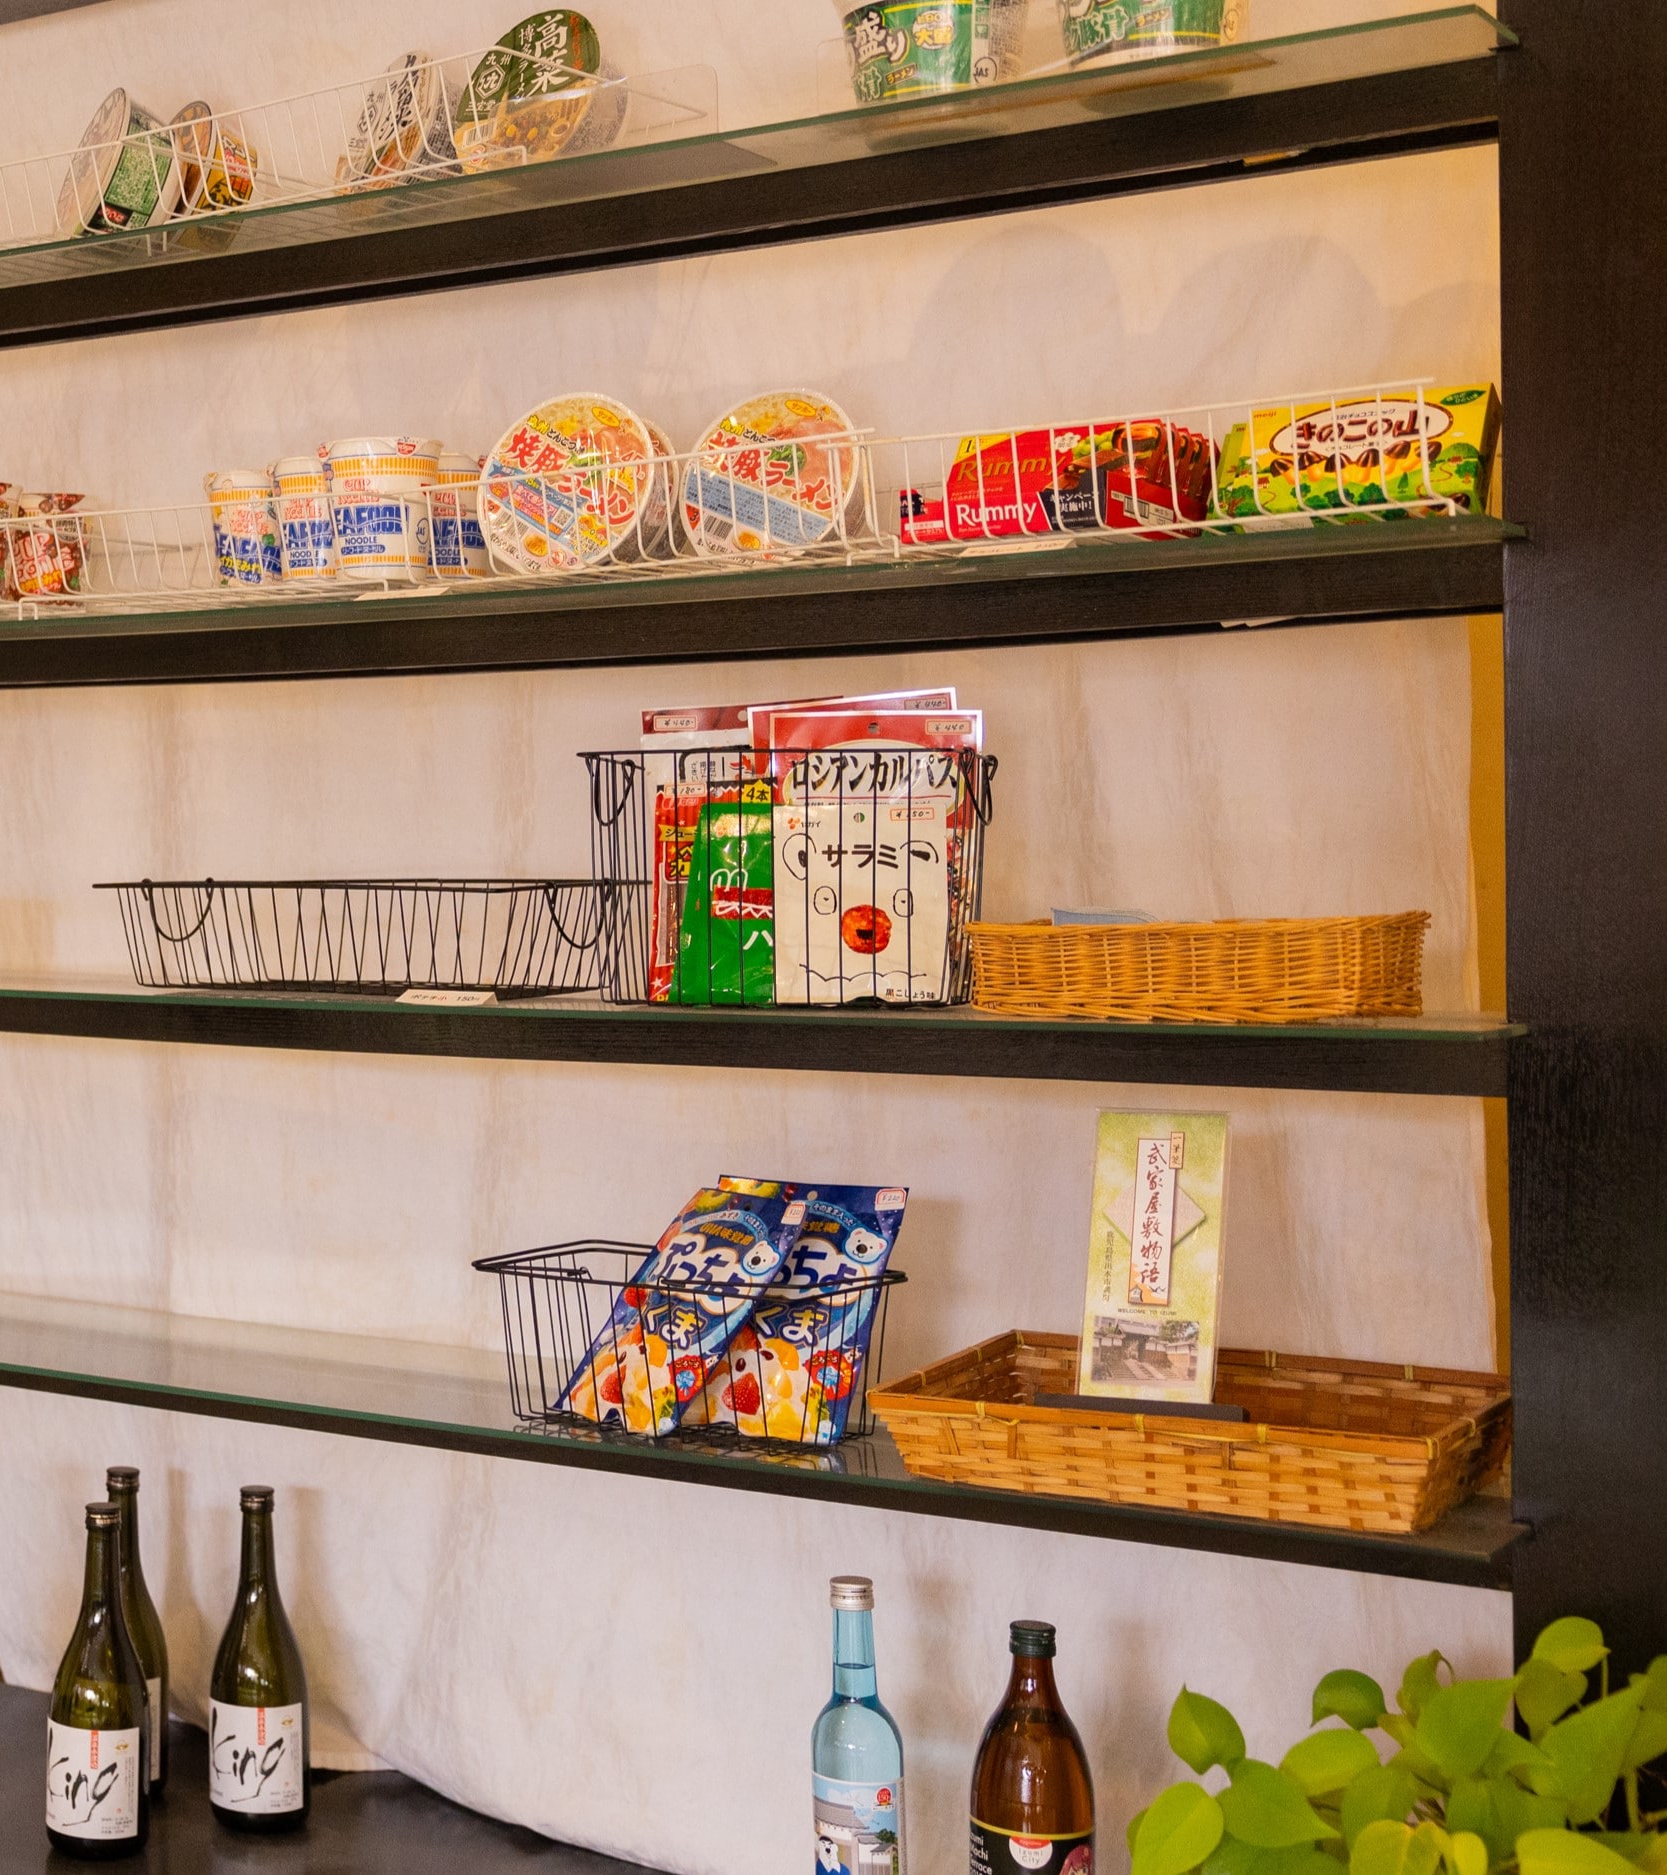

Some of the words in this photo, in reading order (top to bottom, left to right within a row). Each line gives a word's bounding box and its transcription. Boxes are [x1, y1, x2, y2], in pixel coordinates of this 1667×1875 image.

[485, 53, 511, 66] 九州
[1253, 411, 1277, 420] meiji
[1290, 409, 1430, 450] きのこの山
[956, 455, 1067, 483] Rummy
[956, 502, 1037, 527] Rummy
[344, 536, 378, 546] NOODLE
[290, 550, 320, 558] NOODE
[792, 753, 958, 793] ロシアンカルパス
[746, 786, 769, 802] 4本
[821, 844, 899, 869] サラミ
[885, 988, 936, 1000] 黒こしょう味
[1139, 1142, 1168, 1285] 武家屋敷物語
[1117, 1308, 1147, 1316] WELCOME
[1019, 1848, 1043, 1857] Izumi
[1021, 1855, 1041, 1865] City
